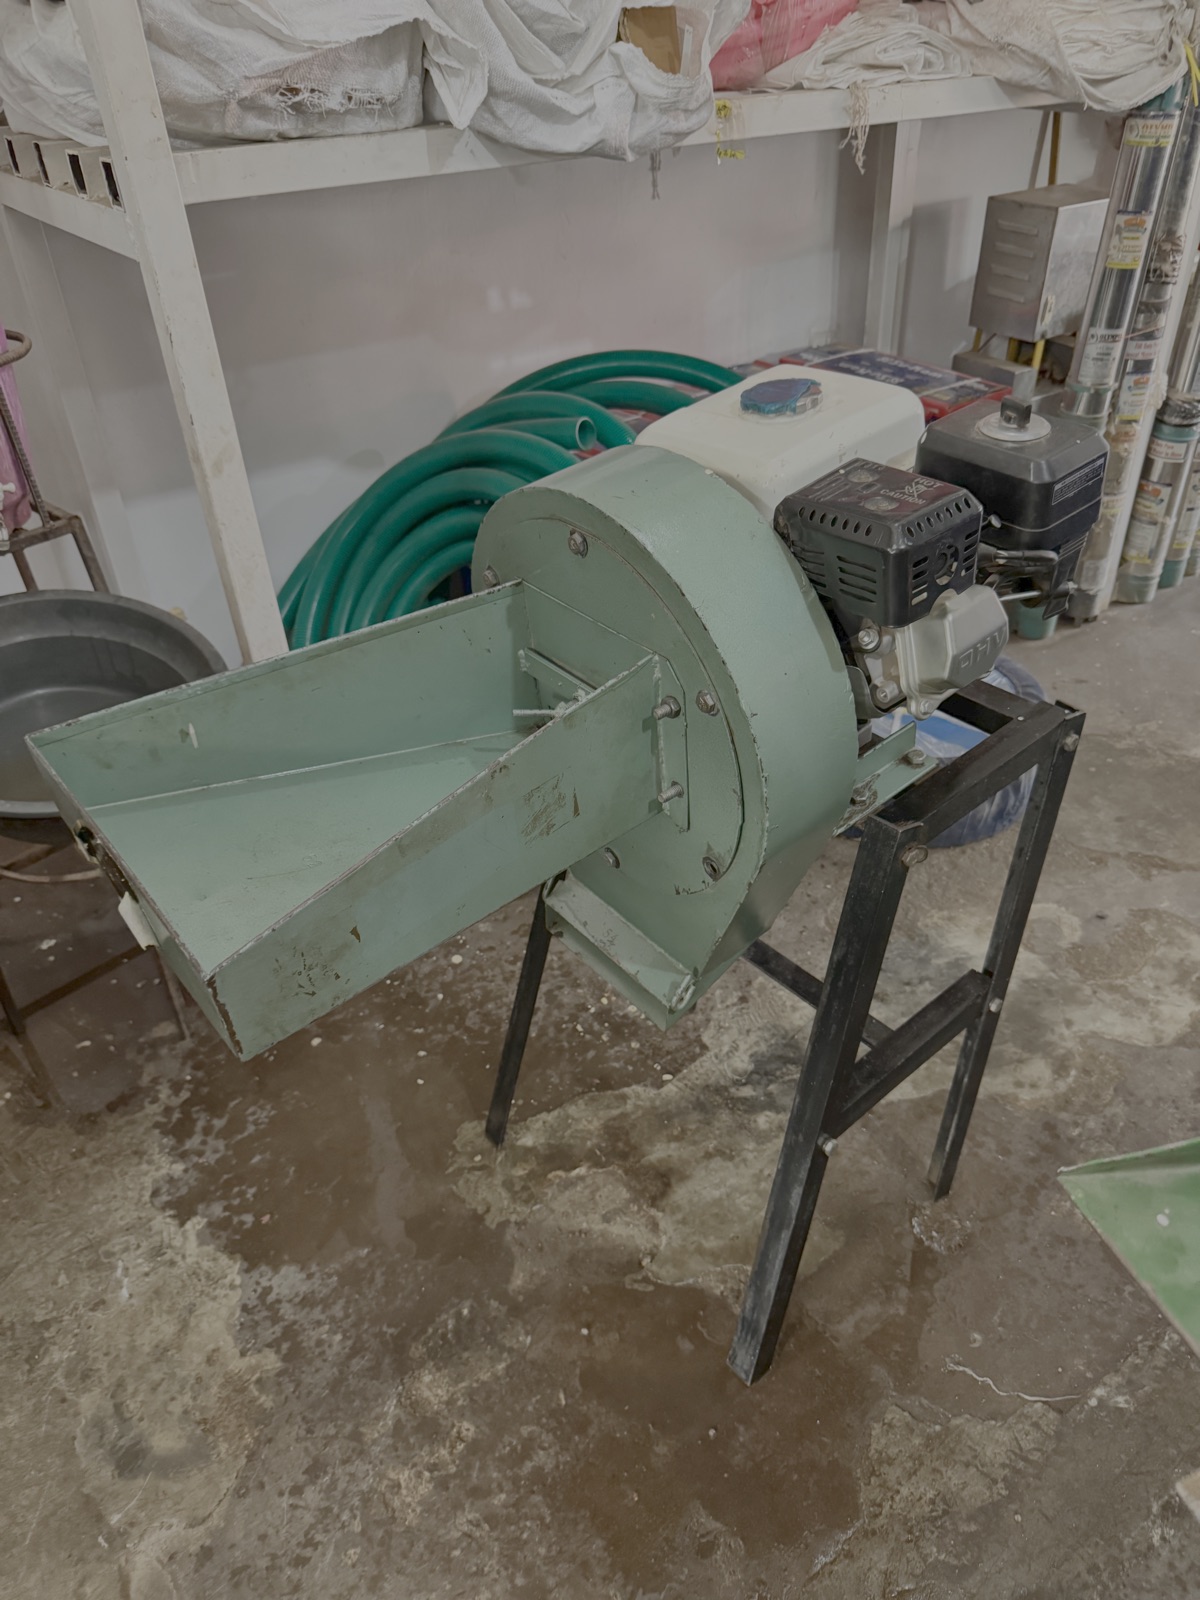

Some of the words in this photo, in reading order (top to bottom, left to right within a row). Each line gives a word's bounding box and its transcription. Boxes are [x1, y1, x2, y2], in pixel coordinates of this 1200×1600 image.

[914, 477, 946, 488] HOT
[880, 489, 926, 505] CAUTION
[959, 627, 1006, 668] OHV
